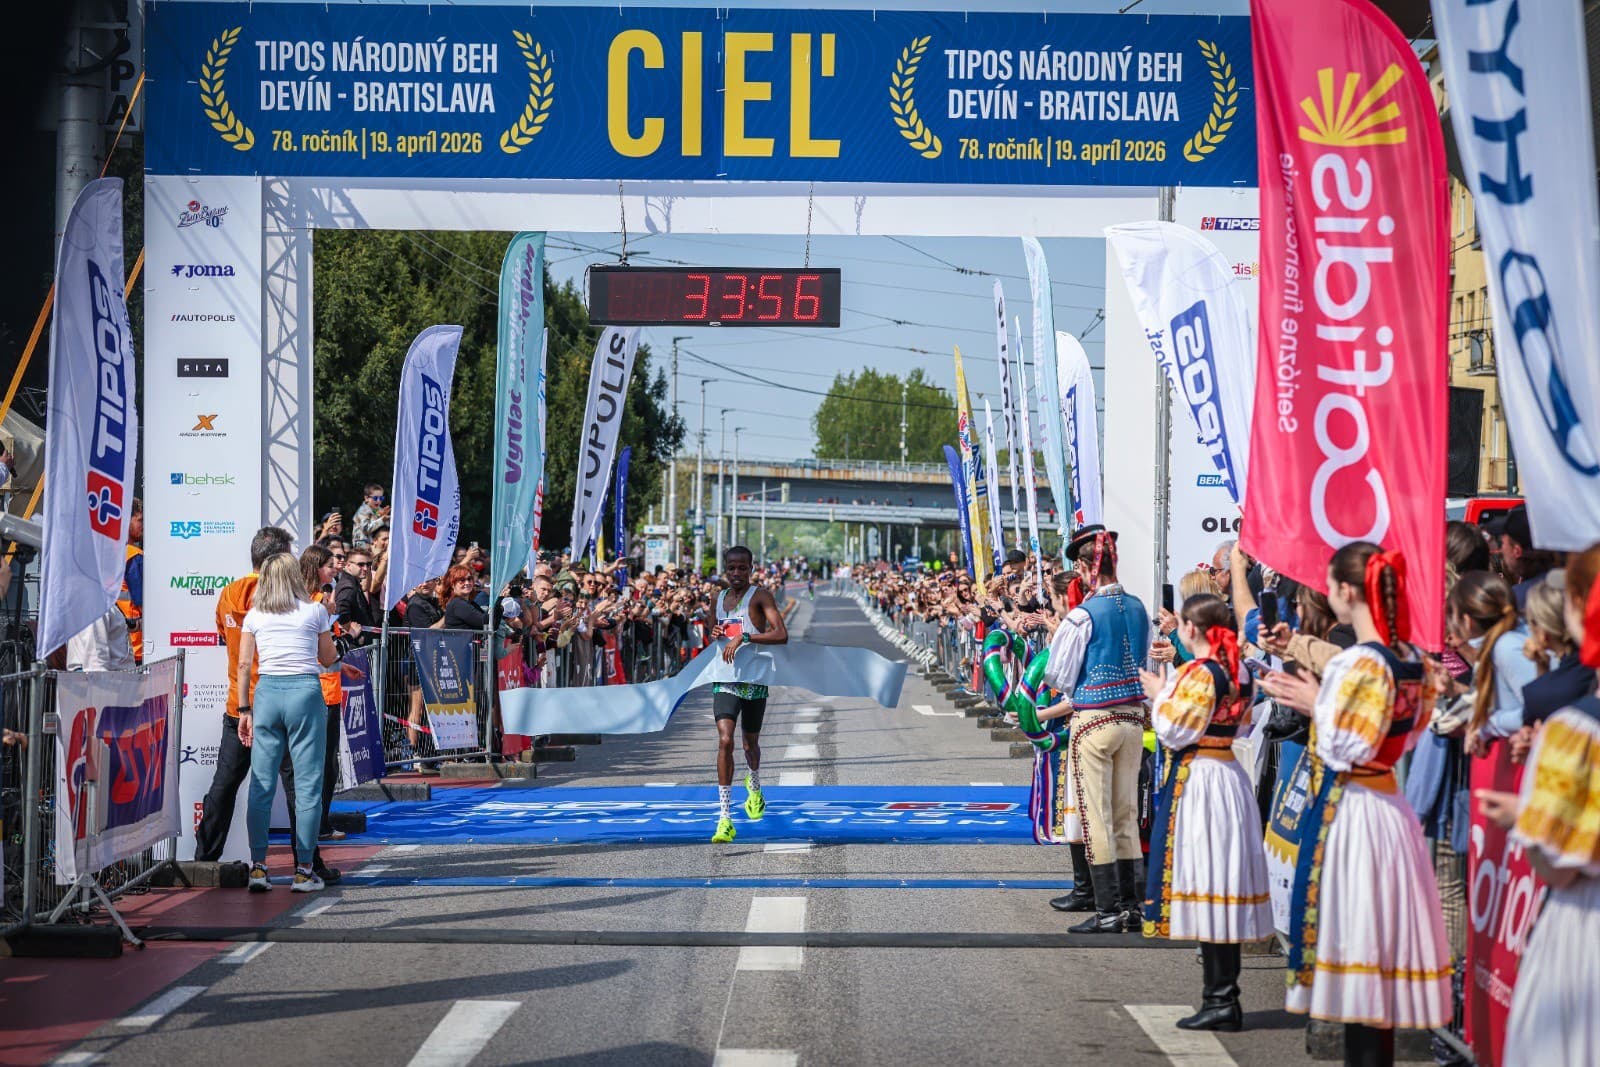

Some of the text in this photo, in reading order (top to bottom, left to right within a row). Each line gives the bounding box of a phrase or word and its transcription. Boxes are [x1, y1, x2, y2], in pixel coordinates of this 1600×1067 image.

[255, 35, 498, 74] TIPOS NÁRODNÝ BEH
[944, 44, 1183, 82] TIPOS NÁRODNÝ BEH
[260, 76, 331, 112] DEVÍN
[353, 82, 496, 113] BRATISLAVA
[607, 29, 841, 158] CIEĽ
[948, 84, 1018, 120] DEVÍN
[1039, 90, 1180, 122] BRATISLAVA
[272, 130, 298, 152] 78.
[302, 129, 359, 152] ročník
[370, 131, 392, 153] 19.
[396, 130, 437, 158] apríl
[440, 132, 482, 153] 2026
[959, 138, 984, 160] 78.
[988, 137, 1043, 160] ročník
[1055, 139, 1077, 161] 19.
[1080, 138, 1121, 166] apríl
[1124, 140, 1166, 162] 2026
[1218, 219, 1260, 229] TIPOS
[683, 274, 821, 320] 33:56
[93, 275, 124, 459] TIPOS
[183, 364, 223, 372] SITA
[419, 382, 444, 493] TIPOS
[581, 332, 626, 527] OPOLIS
[184, 473, 235, 485] behsk
[171, 521, 201, 533] BVS
[170, 576, 235, 589] NUTRITION
[190, 588, 215, 596] CLUB
[173, 635, 215, 644] predpredaj
